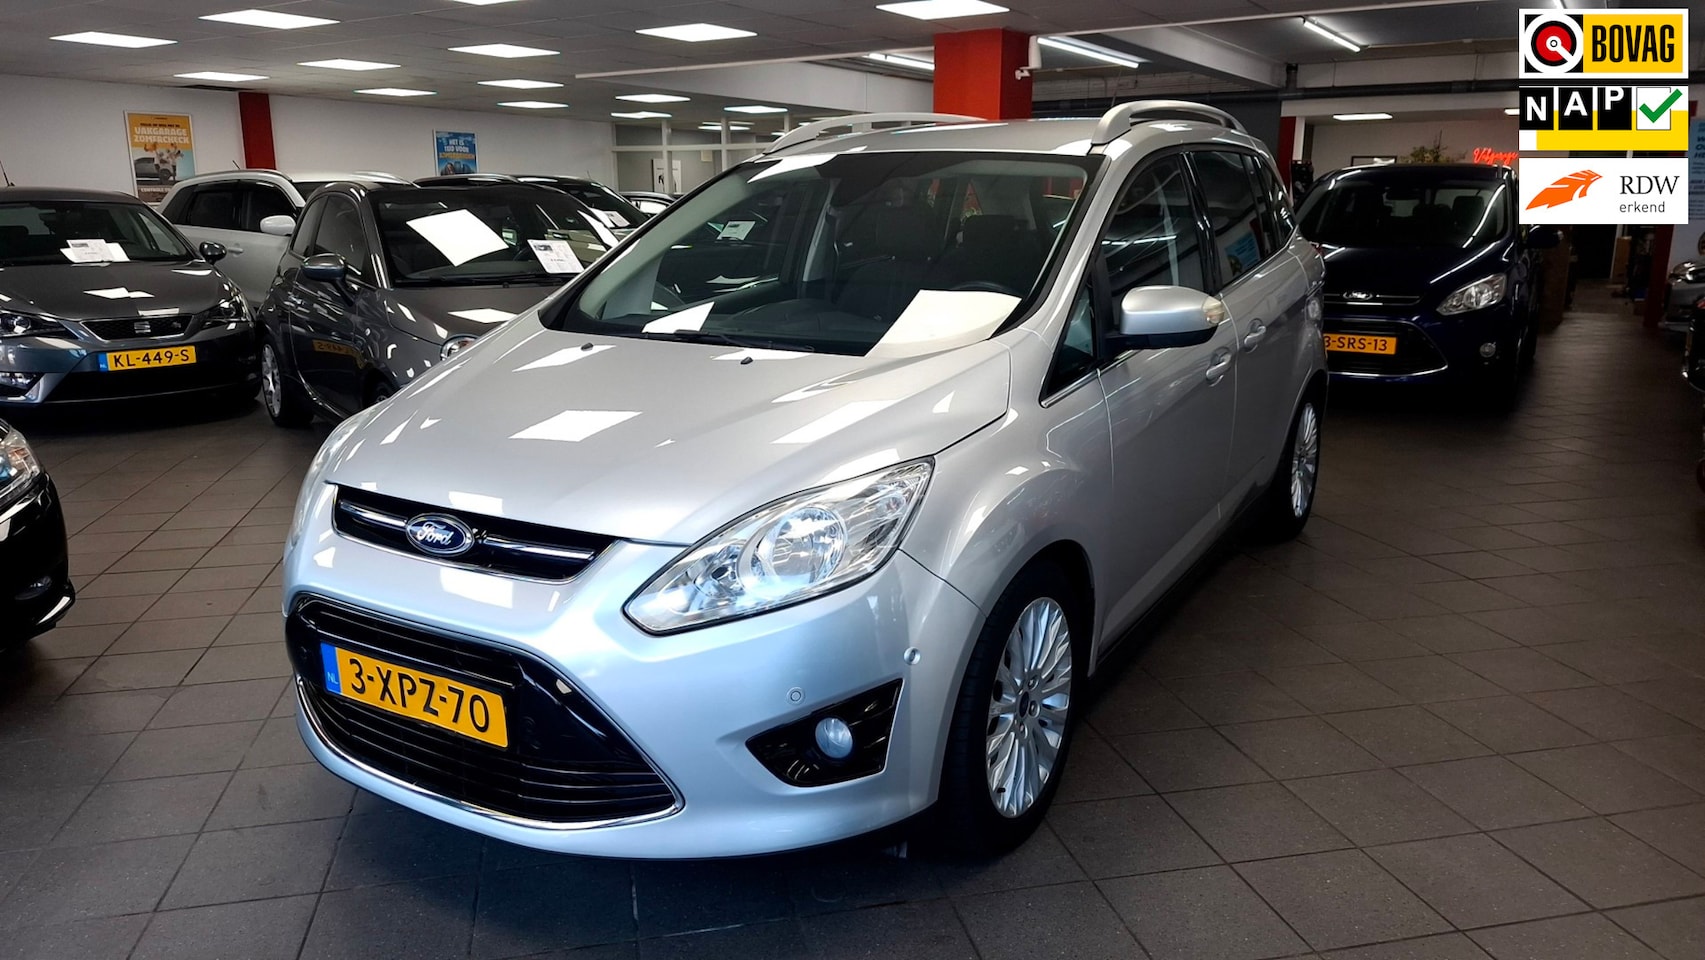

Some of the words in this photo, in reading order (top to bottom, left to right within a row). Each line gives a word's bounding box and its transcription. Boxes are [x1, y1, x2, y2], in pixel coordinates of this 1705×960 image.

[134, 126, 187, 136] VAKGARAGE
[134, 135, 189, 144] ZOMERCHECK
[113, 349, 190, 368] KL-449-S
[416, 521, 454, 545] Ford
[327, 671, 339, 685] NL
[349, 658, 490, 733] 3-XPZ-70
